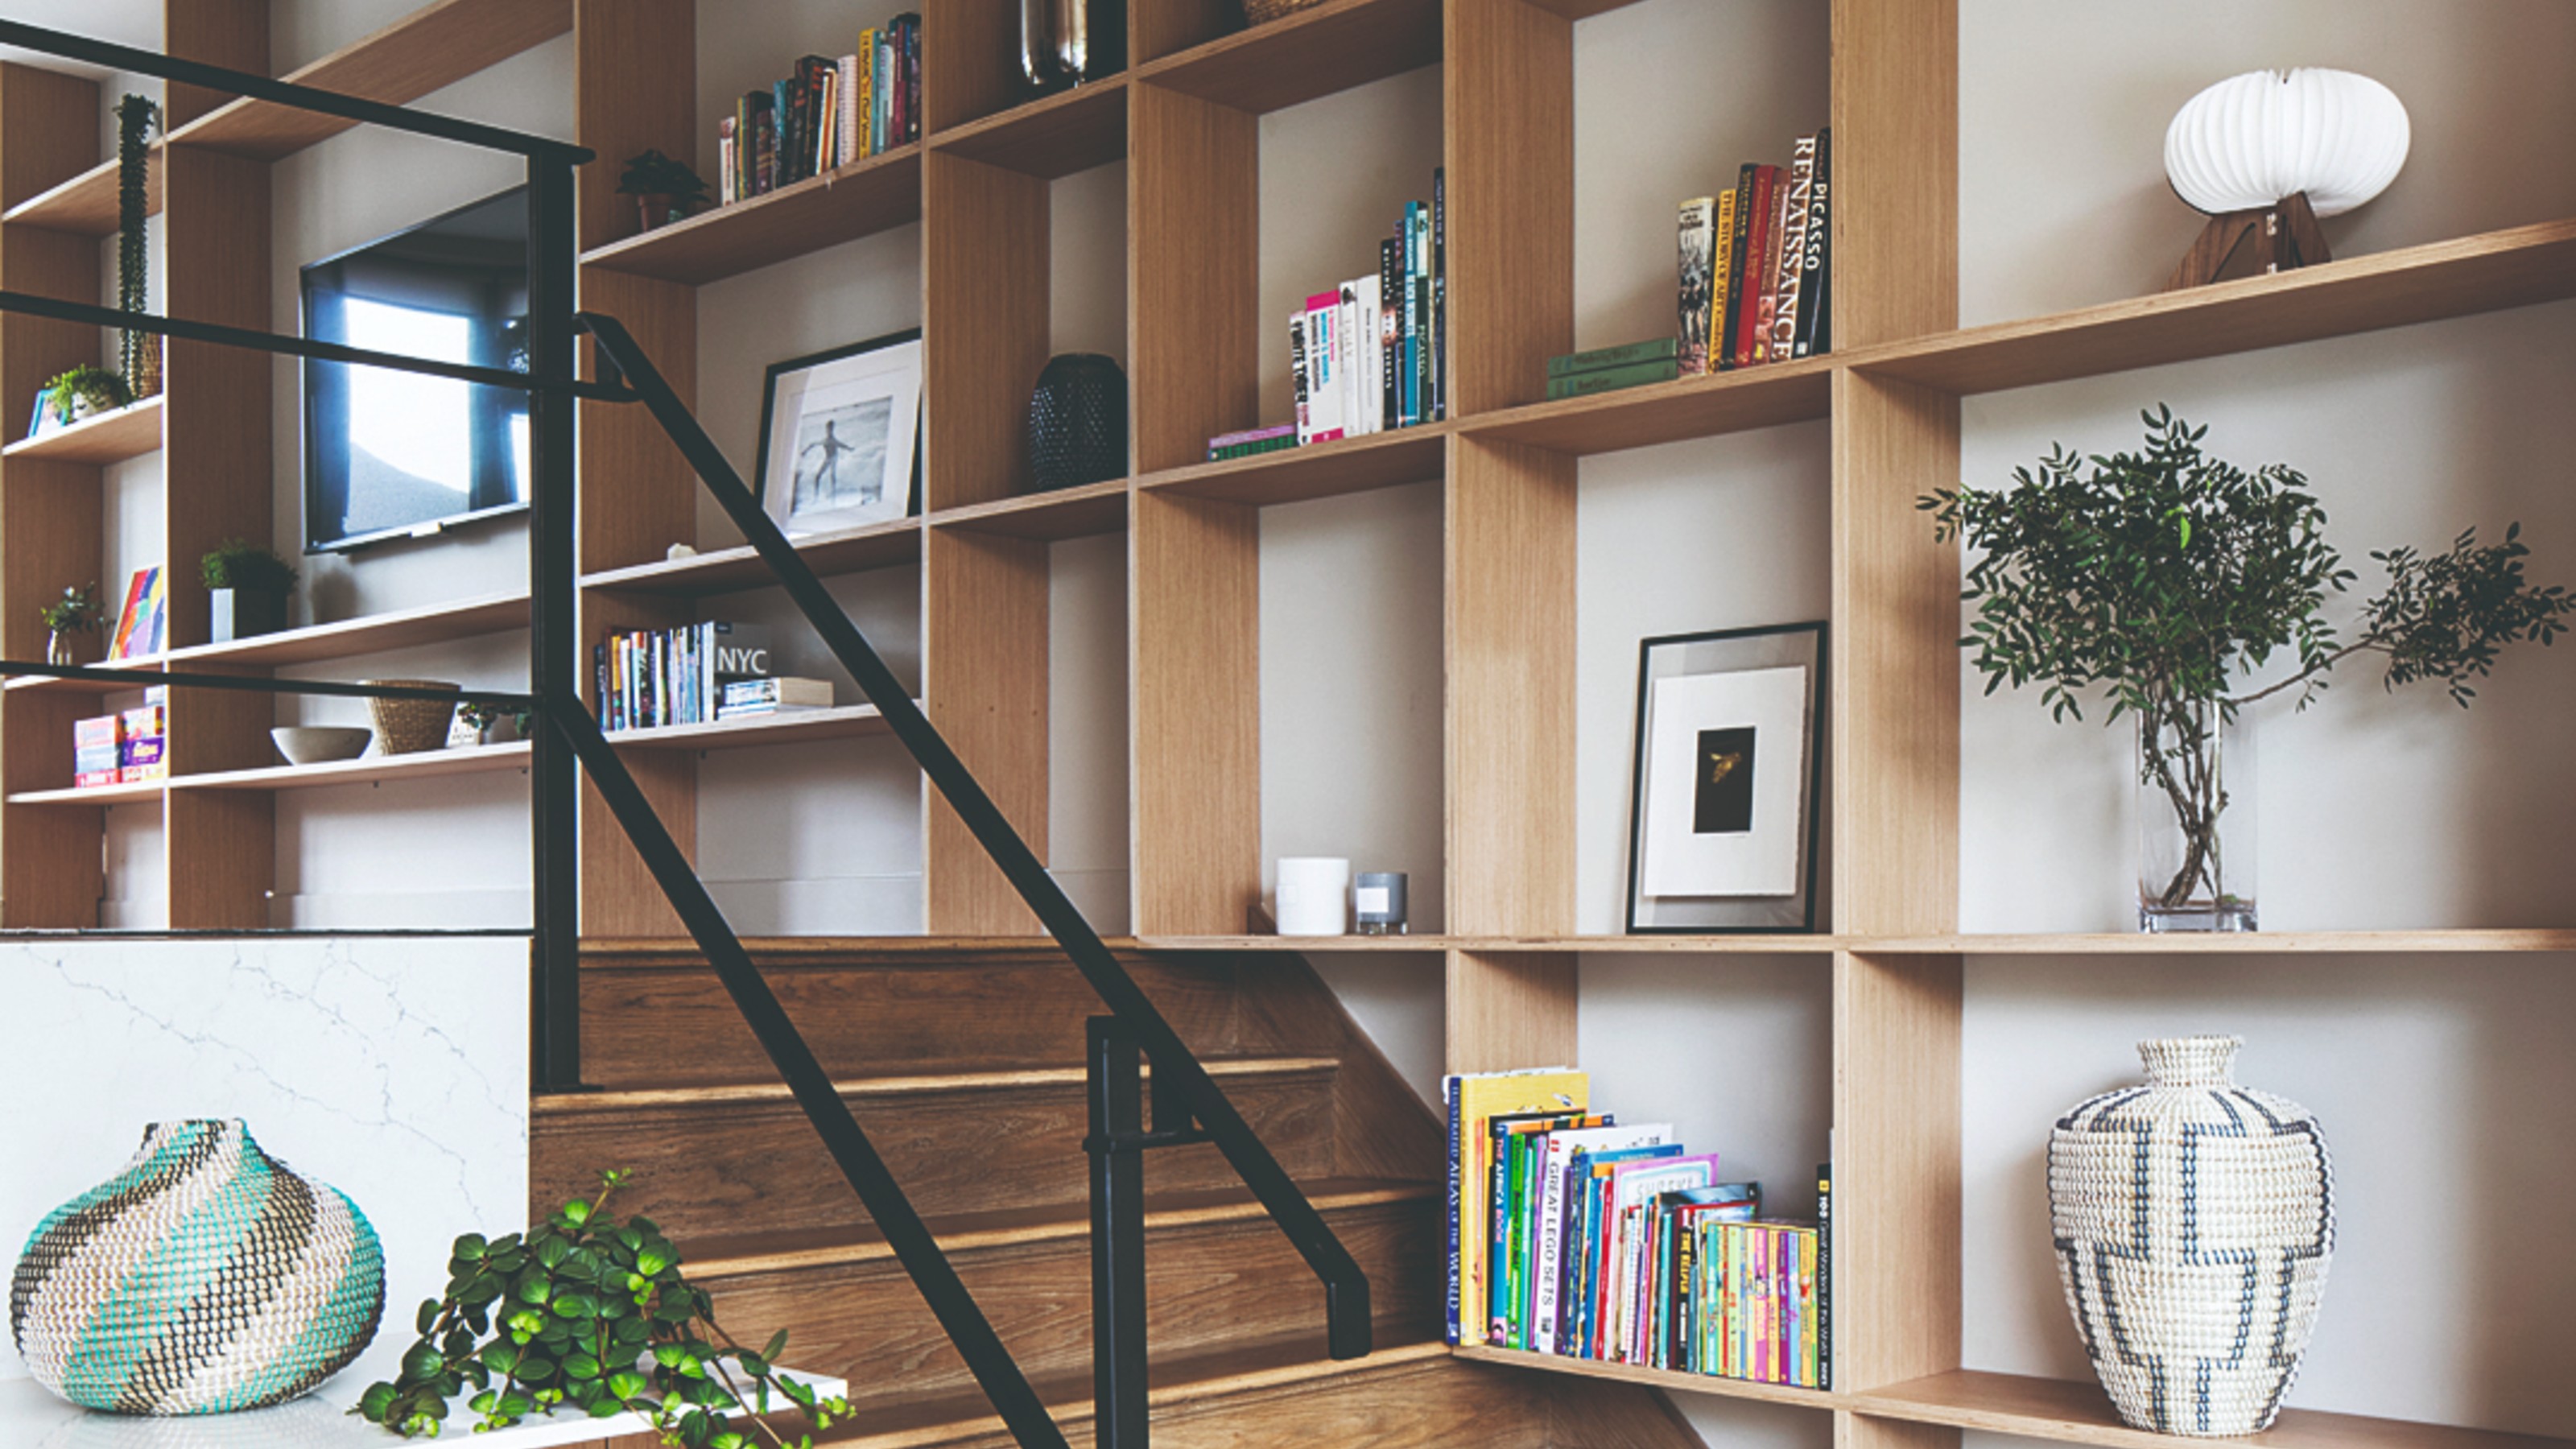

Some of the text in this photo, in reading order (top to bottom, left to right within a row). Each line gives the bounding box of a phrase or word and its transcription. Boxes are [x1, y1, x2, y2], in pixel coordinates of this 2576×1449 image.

[1721, 192, 1732, 216] THE
[1718, 221, 1731, 262] STORY
[1804, 182, 1828, 270] PICASSO
[1771, 136, 1816, 361] RENAISSANCE
[1717, 263, 1728, 279] OF
[1715, 284, 1727, 307] ART
[1384, 346, 1393, 389] EVENTS
[1418, 324, 1427, 377] PICASSO
[717, 646, 768, 675] NYC
[1448, 1087, 1460, 1311] ILLUSTRATED ATLAS OF THE WORLD
[1494, 1138, 1505, 1243] THE AFRICA BOOK
[1818, 1195, 1829, 1219] 100
[1541, 1161, 1560, 1307] GREAT LEGO SETS
[1818, 1220, 1829, 1248] Great
[1819, 1249, 1829, 1295] Wonders
[1820, 1297, 1829, 1308] of
[1820, 1310, 1829, 1326] the
[1819, 1327, 1829, 1356] World
